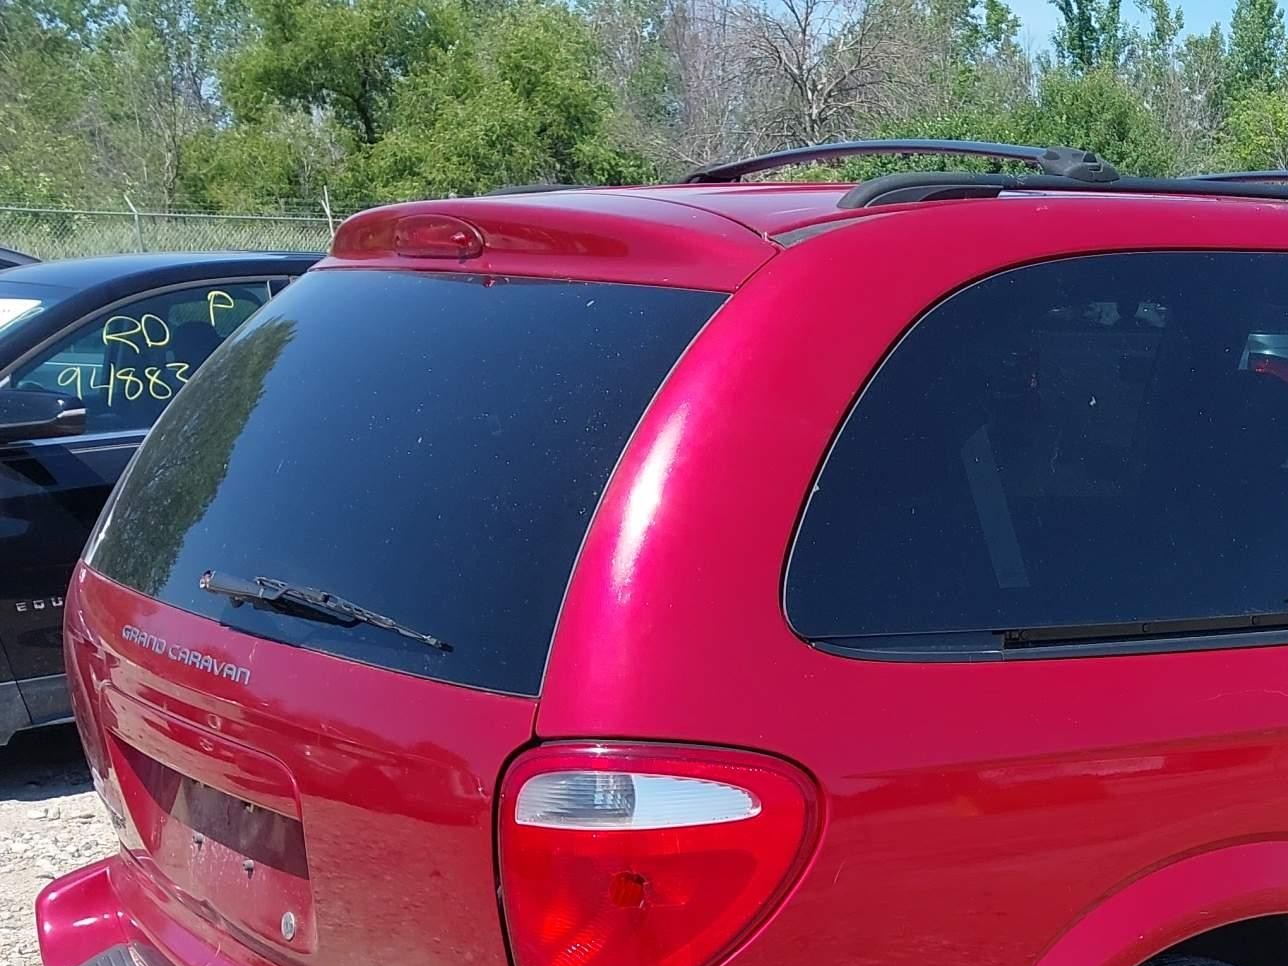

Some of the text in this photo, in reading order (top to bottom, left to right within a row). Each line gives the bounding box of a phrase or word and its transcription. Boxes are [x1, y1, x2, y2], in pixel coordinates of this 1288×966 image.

[207, 290, 234, 327] P
[102, 314, 170, 354] RD
[122, 624, 251, 685] GRAND CARAVAN
